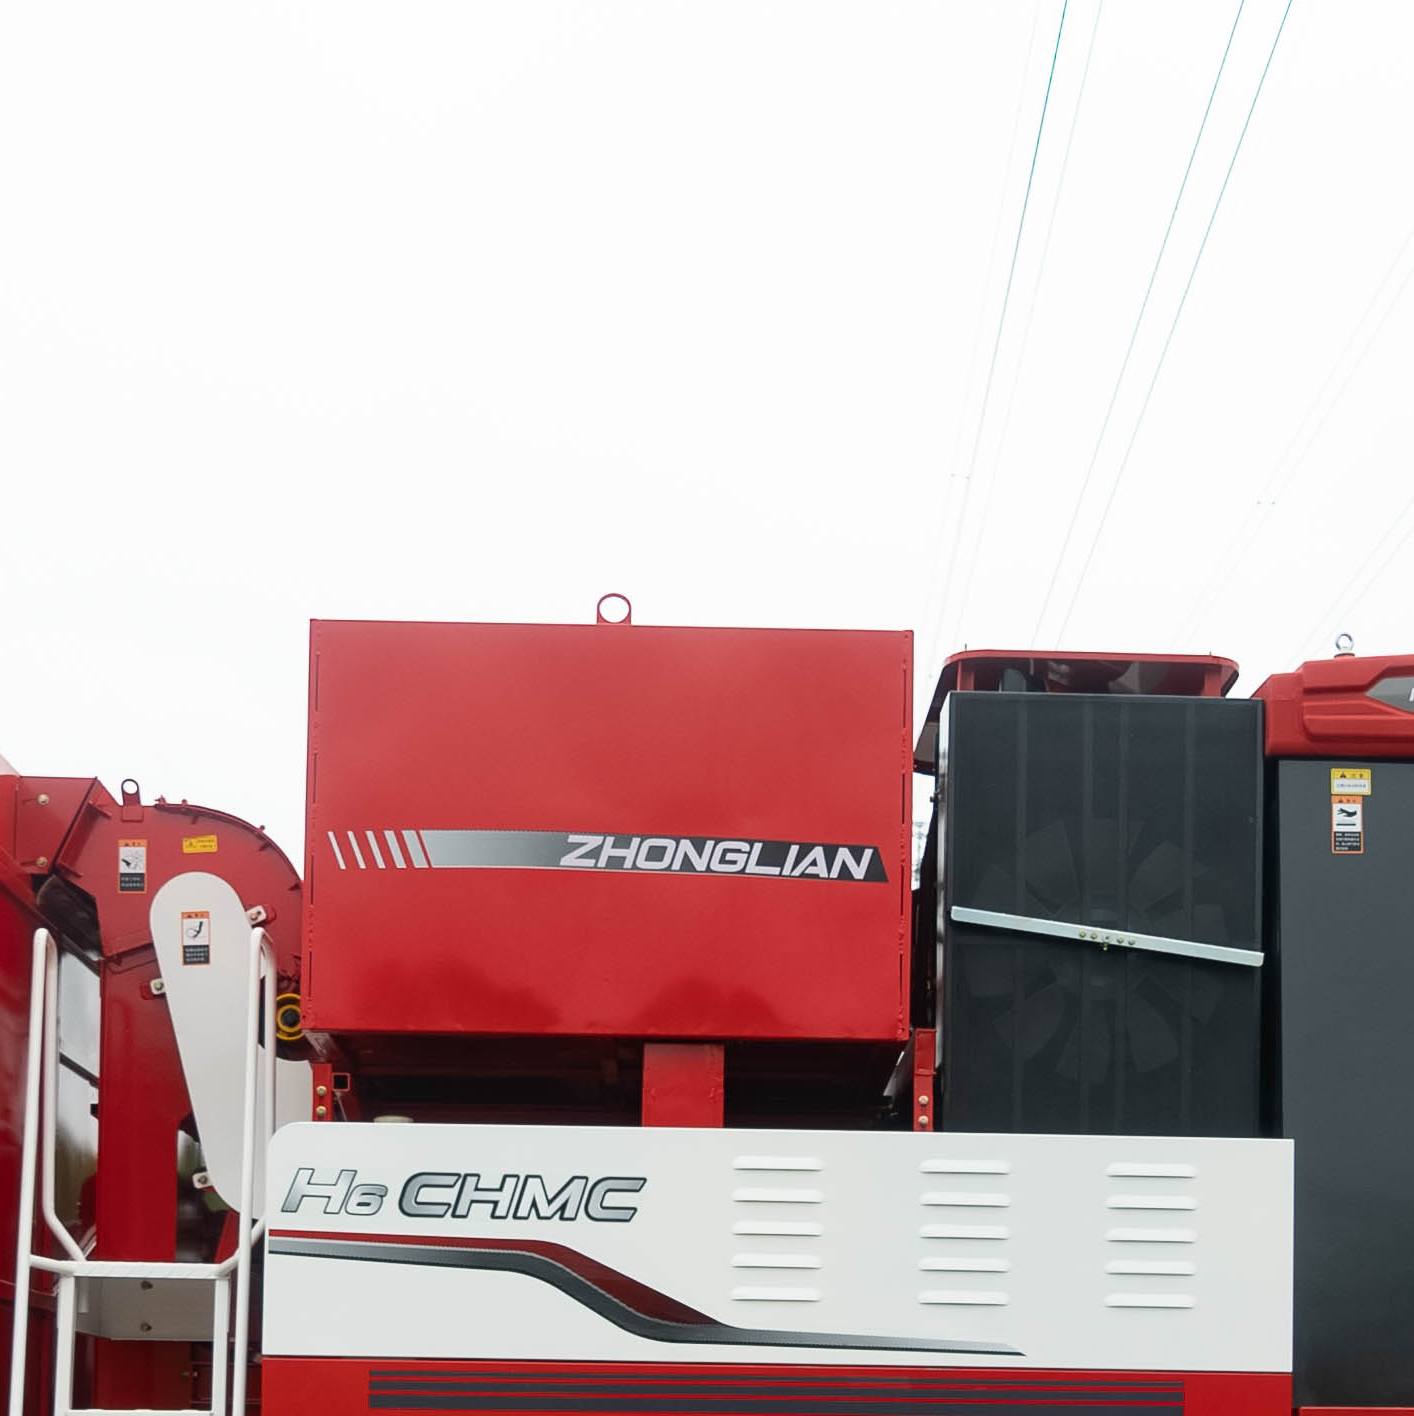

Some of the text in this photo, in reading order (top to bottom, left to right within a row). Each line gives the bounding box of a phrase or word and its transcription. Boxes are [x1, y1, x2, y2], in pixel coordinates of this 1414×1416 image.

[559, 834, 874, 881] ZHONGLIAN
[281, 1167, 648, 1223] H6 CHMC
